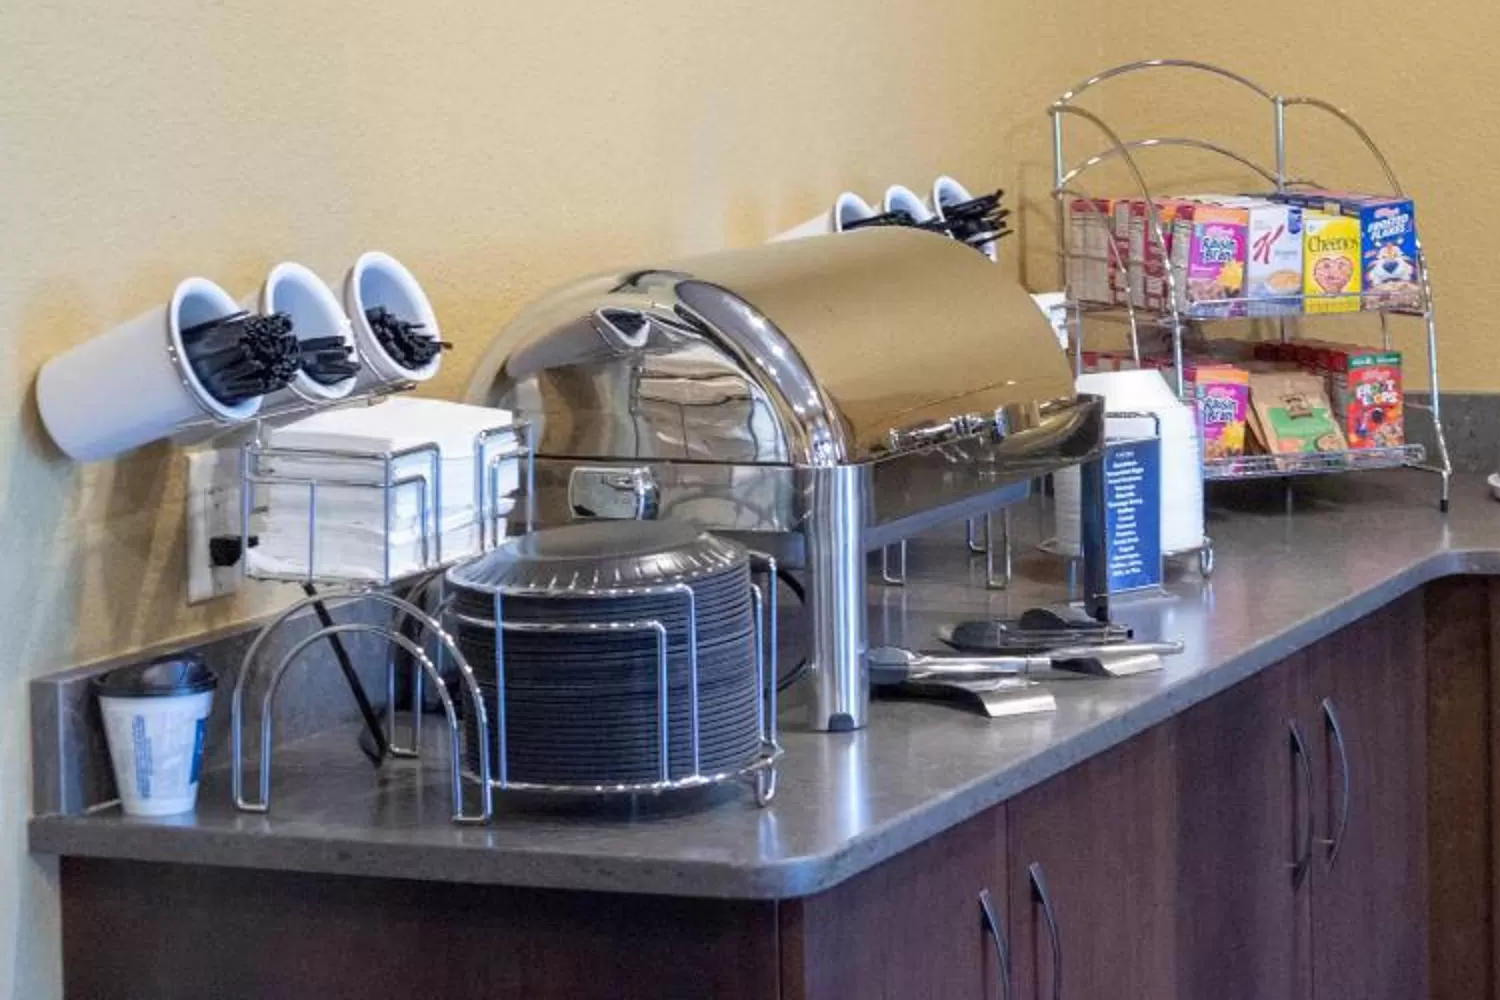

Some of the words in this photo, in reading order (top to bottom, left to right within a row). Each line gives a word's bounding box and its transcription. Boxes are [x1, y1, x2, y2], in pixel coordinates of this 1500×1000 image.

[1202, 236, 1236, 251] Raisin
[1204, 248, 1234, 263] Bran
[1202, 397, 1237, 411] Raisin
[1203, 408, 1235, 423] Bran
